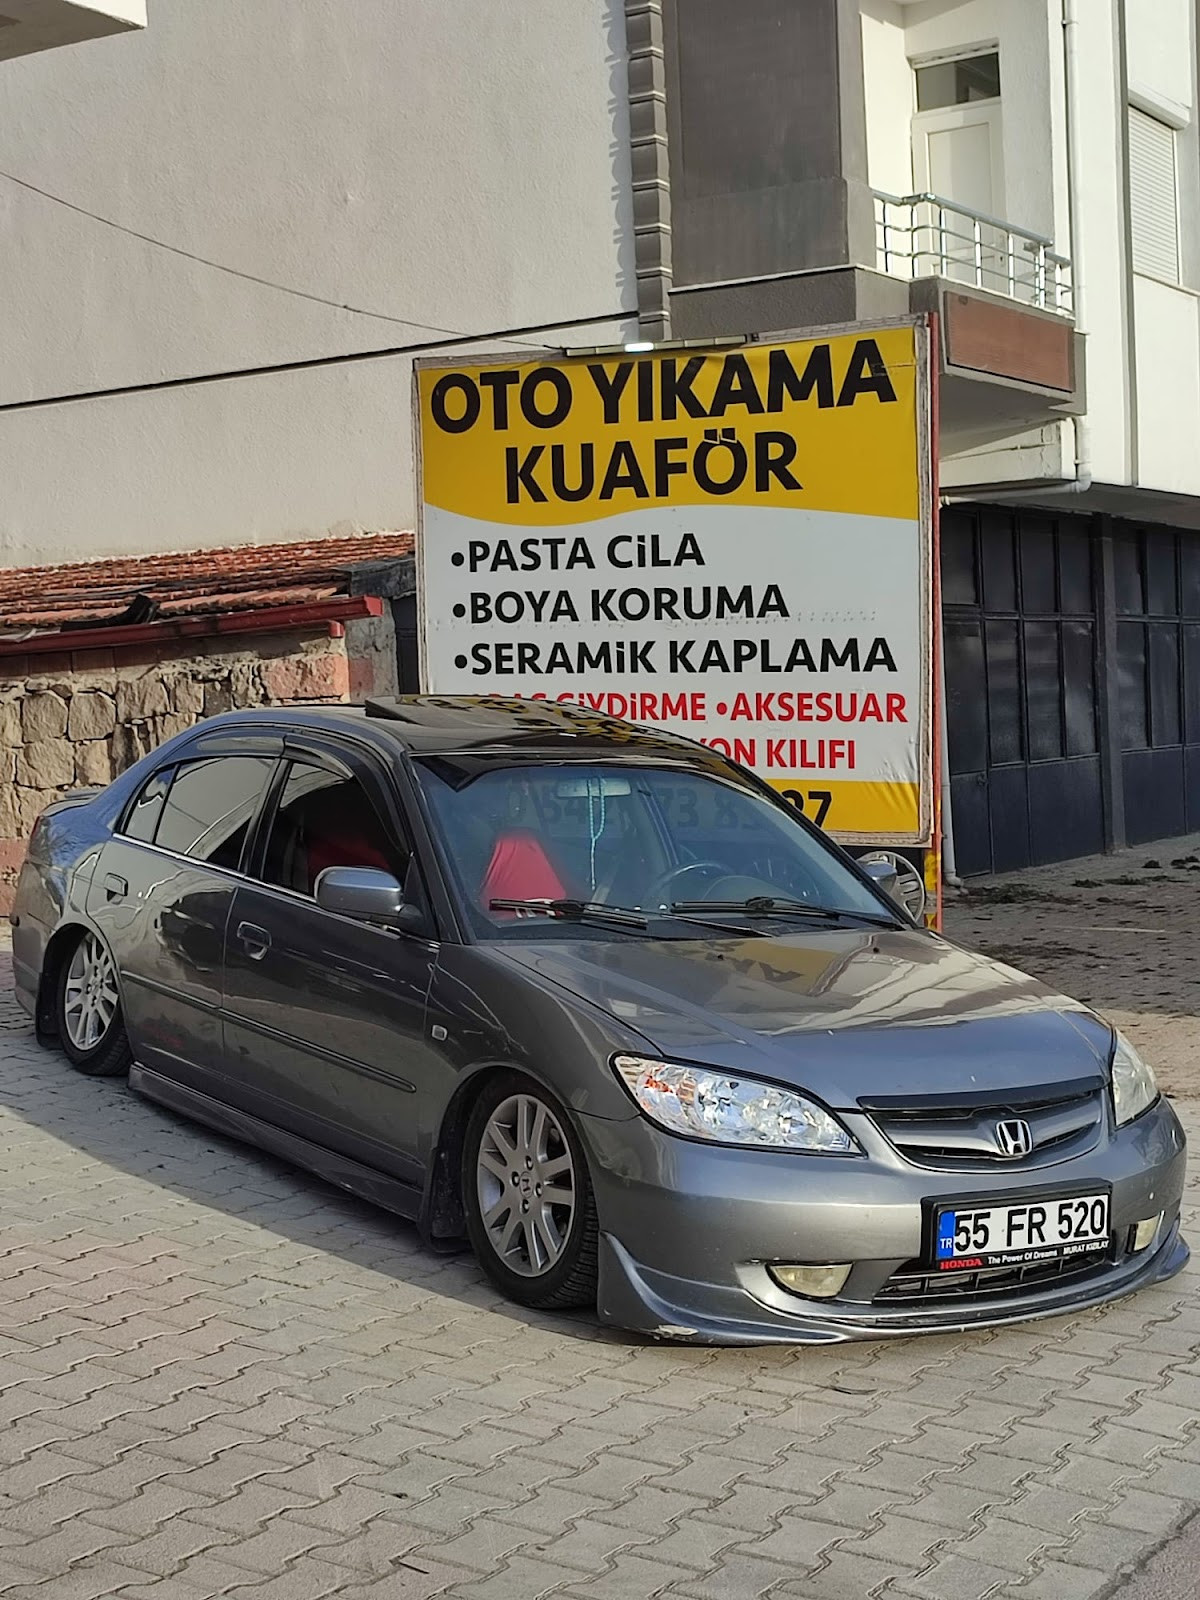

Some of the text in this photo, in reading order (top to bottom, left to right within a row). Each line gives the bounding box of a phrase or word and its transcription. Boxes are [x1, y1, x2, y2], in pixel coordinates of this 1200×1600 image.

[431, 338, 898, 434] OTO YIKAMA
[505, 427, 803, 503] KUAFÖR
[468, 537, 596, 573] PASTA
[470, 585, 791, 624] BOYA KORUMA
[669, 638, 898, 674] KAPLAMA
[730, 692, 909, 723] AKSESUAR
[766, 738, 856, 769] KILIFI
[940, 1199, 1105, 1252] TR 55 FR 520
[940, 1258, 983, 1270] HONDA
[987, 1256, 1000, 1265] The
[1002, 1253, 1023, 1264] Power
